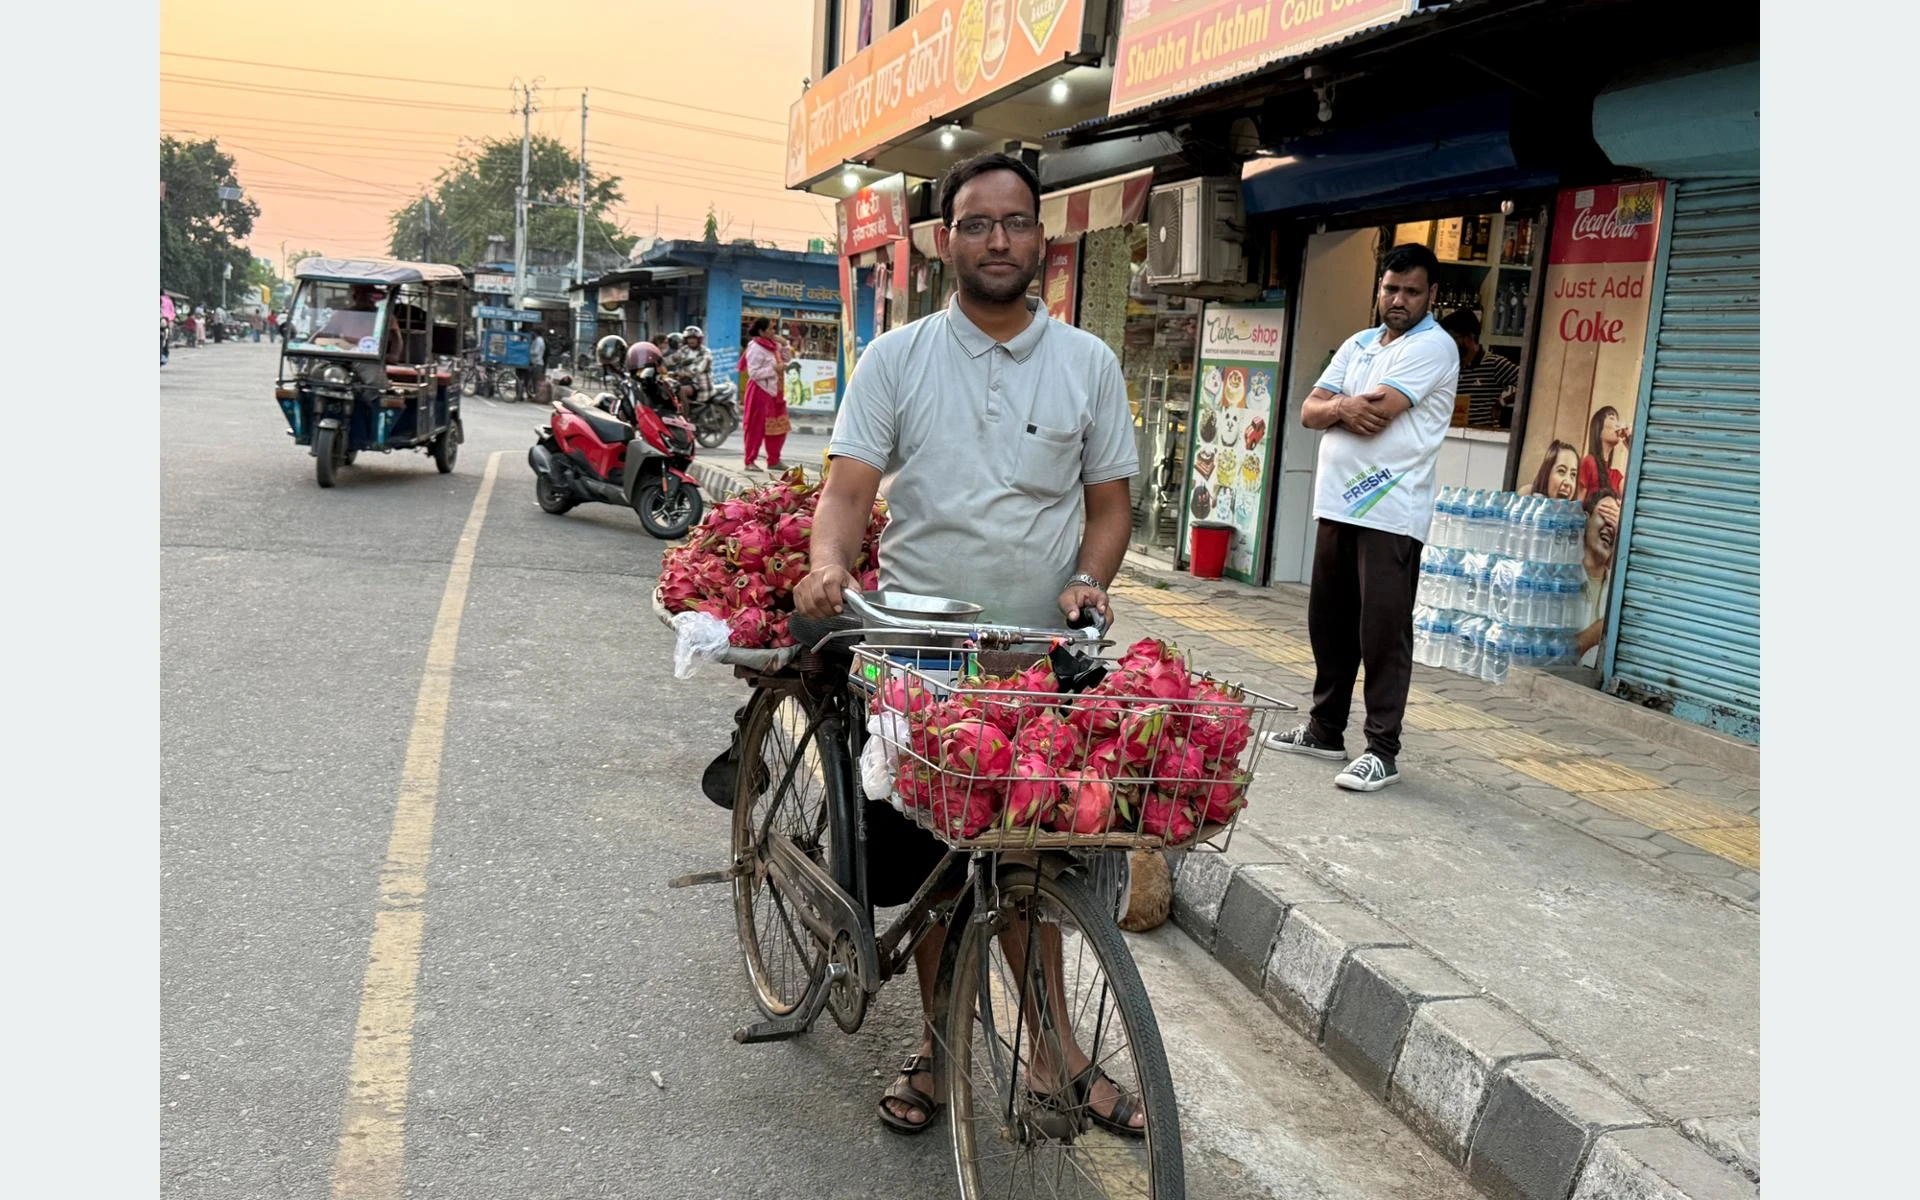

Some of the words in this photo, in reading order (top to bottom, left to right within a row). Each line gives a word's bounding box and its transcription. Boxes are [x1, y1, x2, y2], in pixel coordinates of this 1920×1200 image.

[1191, 0, 1272, 65] Lakshmi
[874, 54, 906, 118] एण्ड
[906, 8, 953, 98] बेकरी
[1554, 278, 1597, 299] Just
[1601, 275, 1645, 299] Add
[1207, 316, 1239, 344] Cake
[1251, 323, 1278, 347] shop
[1559, 308, 1624, 344] Coke
[1342, 468, 1392, 504] FRESH!
